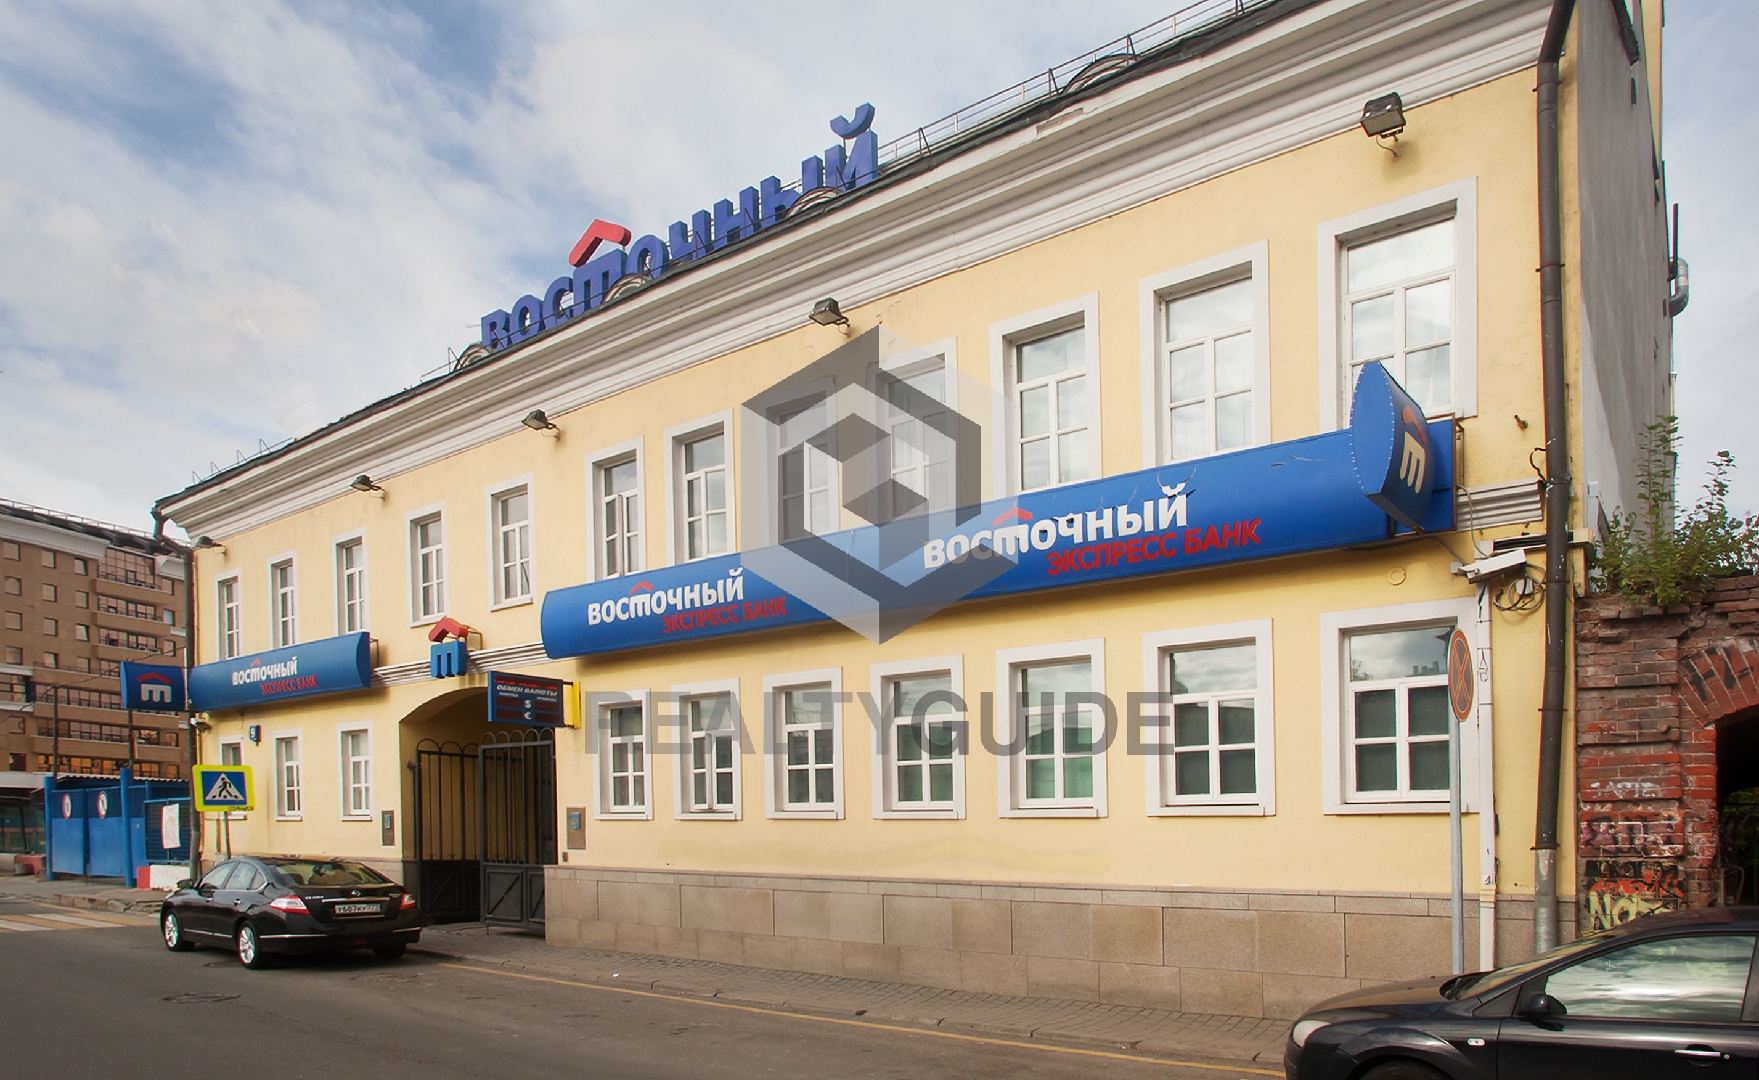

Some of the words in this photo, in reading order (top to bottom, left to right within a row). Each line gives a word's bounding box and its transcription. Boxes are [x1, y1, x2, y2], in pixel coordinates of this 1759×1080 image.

[1046, 534, 1178, 576] ЭКСПРЕСС
[1183, 518, 1262, 555] БАНК
[661, 603, 741, 634] ЭКСПРЕСС
[742, 596, 789, 621] БАНК
[260, 678, 297, 695] ЭКСПРЕСС
[297, 675, 319, 692] БАНК
[496, 684, 524, 693] ОБМЕН
[524, 688, 558, 697] ВАЛЮТЫ
[524, 699, 531, 709] $
[523, 711, 532, 720] €
